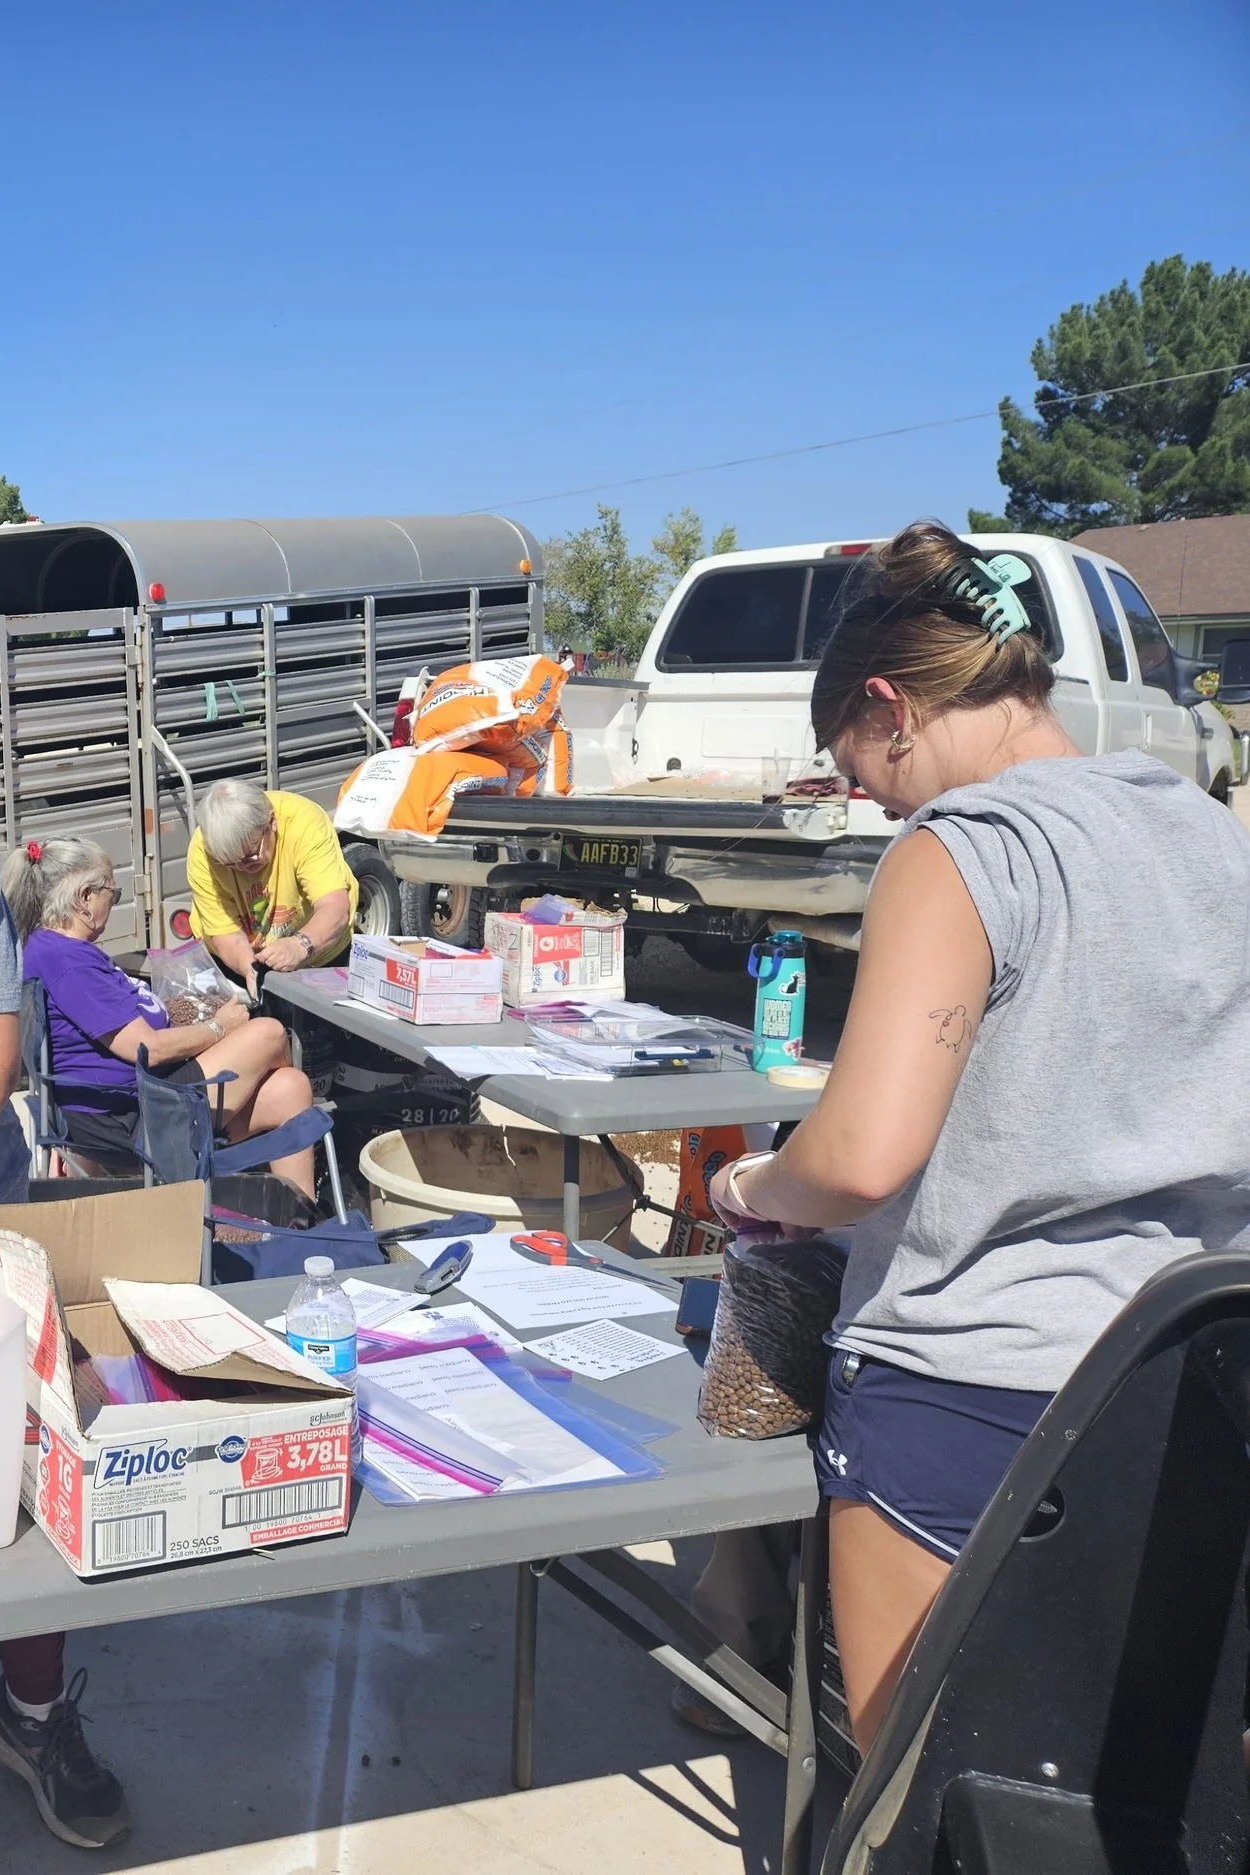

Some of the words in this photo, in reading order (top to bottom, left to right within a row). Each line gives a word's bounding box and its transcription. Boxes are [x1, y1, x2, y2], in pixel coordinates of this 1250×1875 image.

[581, 842, 638, 865] AAFB33
[401, 1108, 425, 1122] 28
[284, 1426, 349, 1445] ENTREPOSAGE
[287, 1439, 348, 1472] 3,78L
[103, 1446, 187, 1486] Ziploc
[320, 1462, 348, 1472] GRAND
[170, 1540, 190, 1551] 250
[192, 1535, 220, 1548] SACS
[253, 1528, 297, 1541] EMBALLAGE
